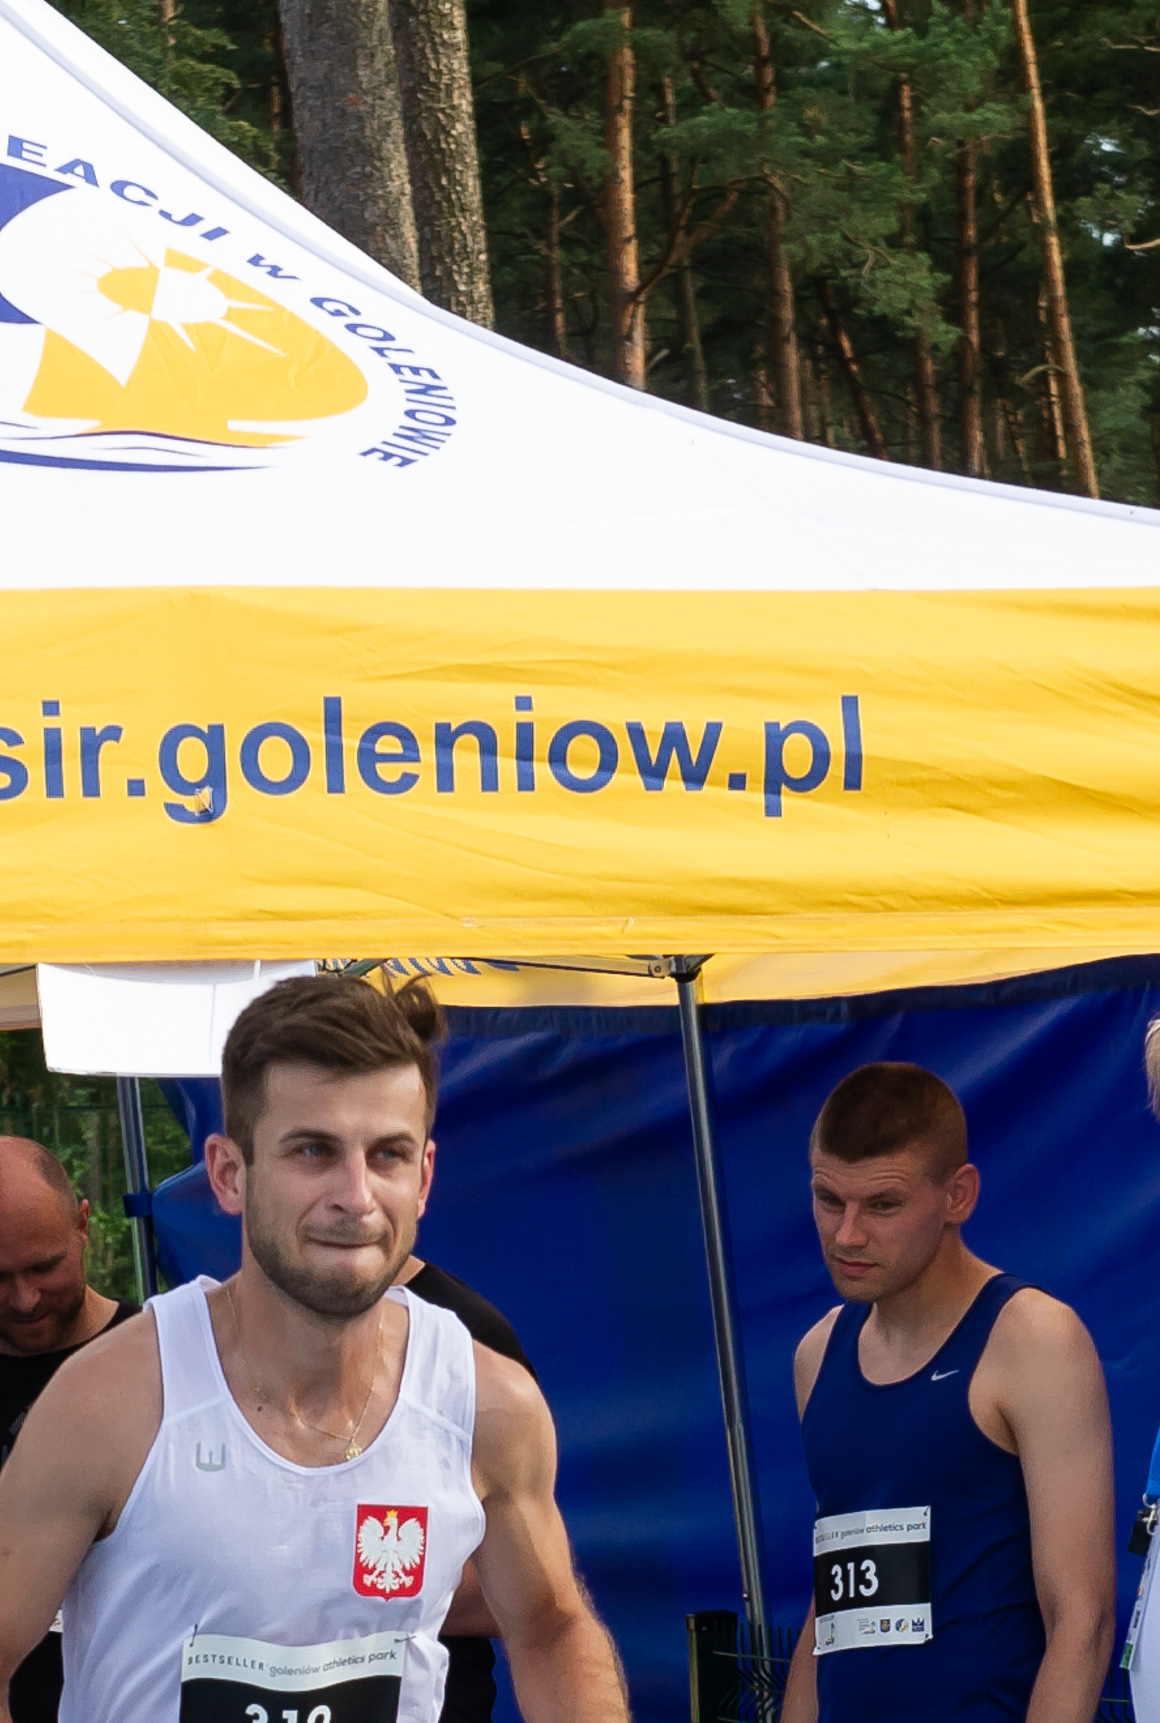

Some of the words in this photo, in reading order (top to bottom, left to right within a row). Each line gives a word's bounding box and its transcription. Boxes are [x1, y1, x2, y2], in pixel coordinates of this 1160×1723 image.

[310, 297, 458, 468] GOLENIOWIE
[906, 1521, 926, 1532] park
[830, 1559, 879, 1601] 313
[187, 1653, 265, 1671] BESTSELLER
[322, 1654, 366, 1672] athletics
[368, 1649, 398, 1664] park
